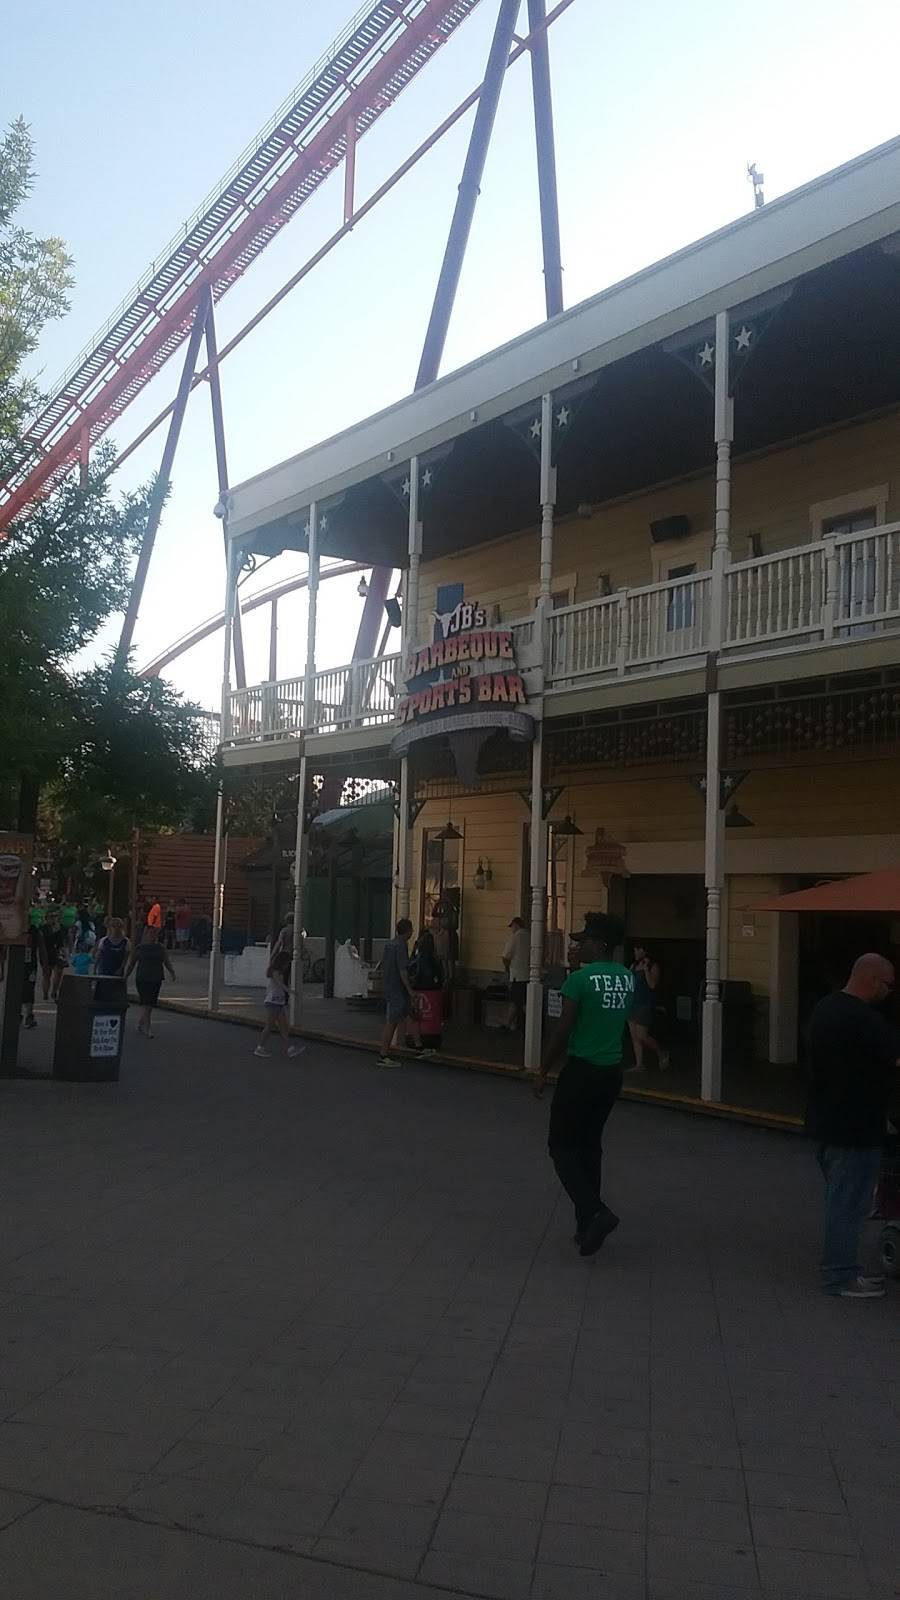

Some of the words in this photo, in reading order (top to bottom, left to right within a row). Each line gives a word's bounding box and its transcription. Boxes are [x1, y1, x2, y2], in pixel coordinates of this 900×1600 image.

[450, 603, 484, 633] JB's
[407, 632, 513, 679] BARBEQUE
[451, 666, 470, 678] AND
[398, 677, 471, 725] SPORTS
[478, 673, 527, 704] BAR
[590, 975, 634, 992] TEAM
[602, 992, 626, 1009] SIX
